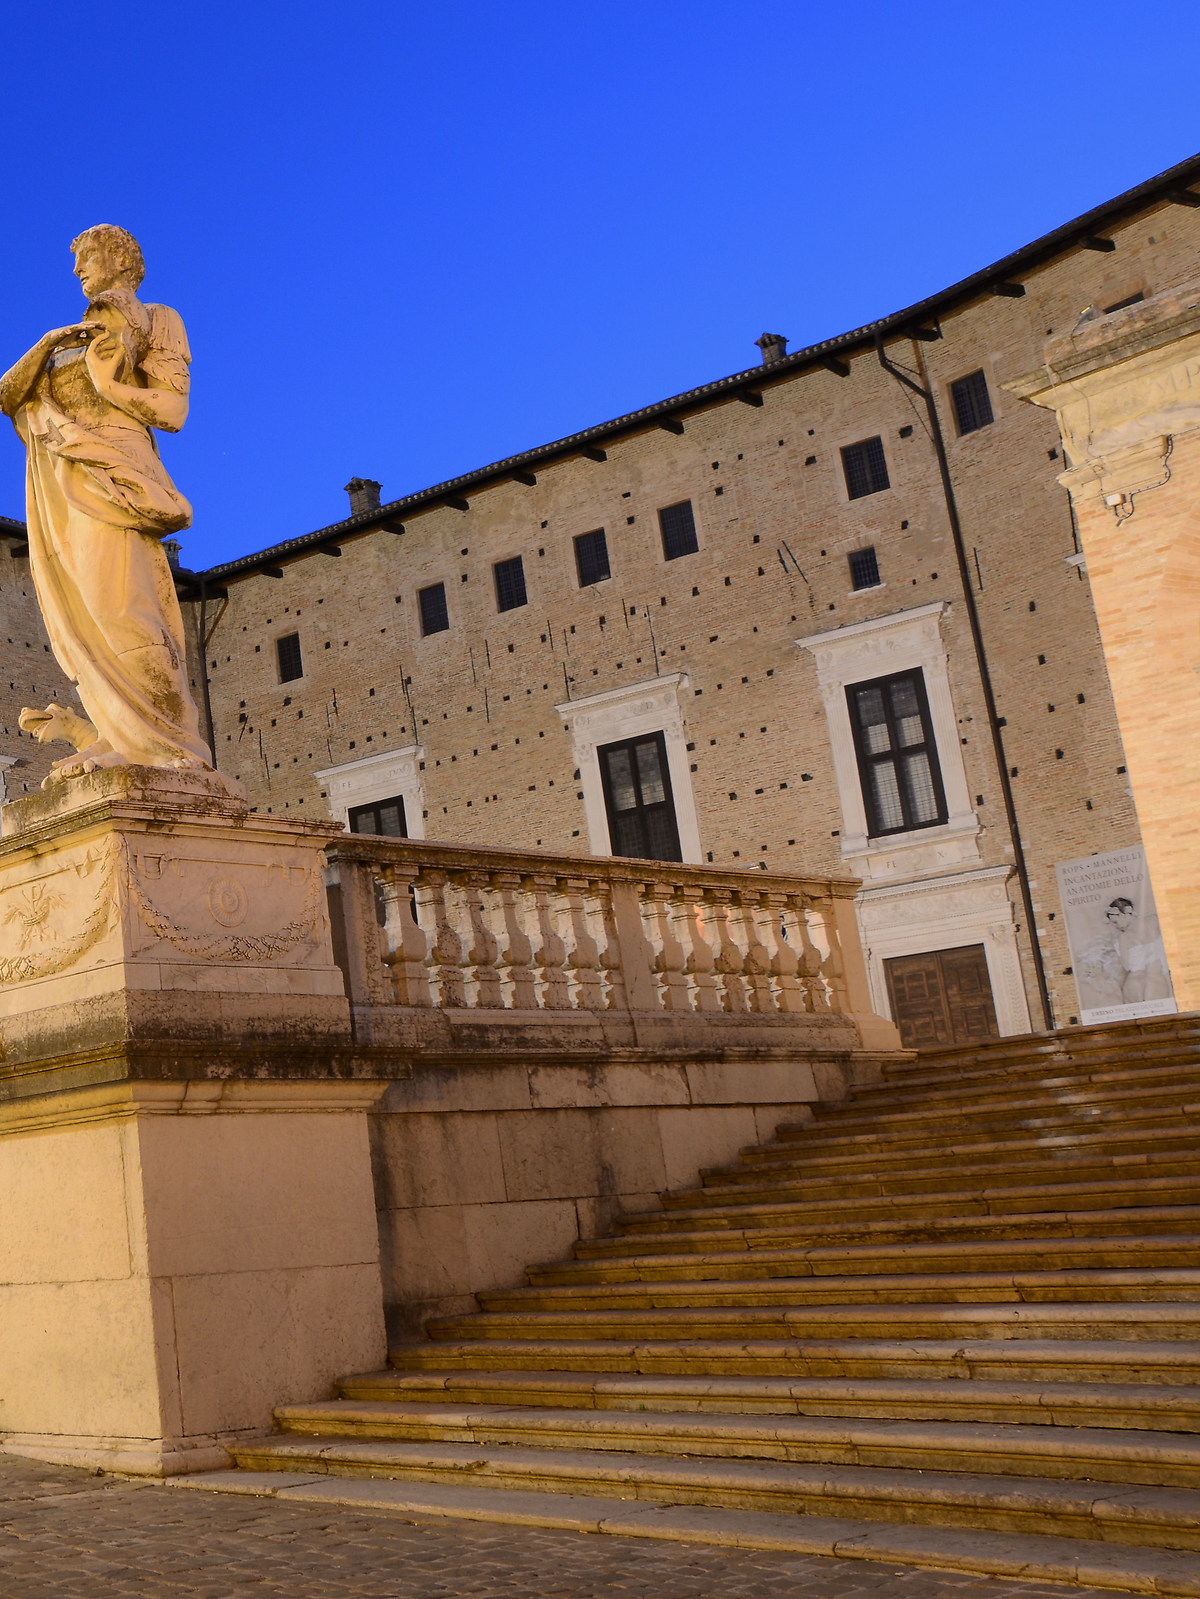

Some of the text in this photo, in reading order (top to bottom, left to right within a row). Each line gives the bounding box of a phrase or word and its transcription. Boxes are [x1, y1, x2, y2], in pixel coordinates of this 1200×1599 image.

[1062, 852, 1142, 875] ROPS MANNELLI
[1067, 873, 1145, 896] ANATOMIE DELLO
[1067, 893, 1102, 907] SPIRITO
